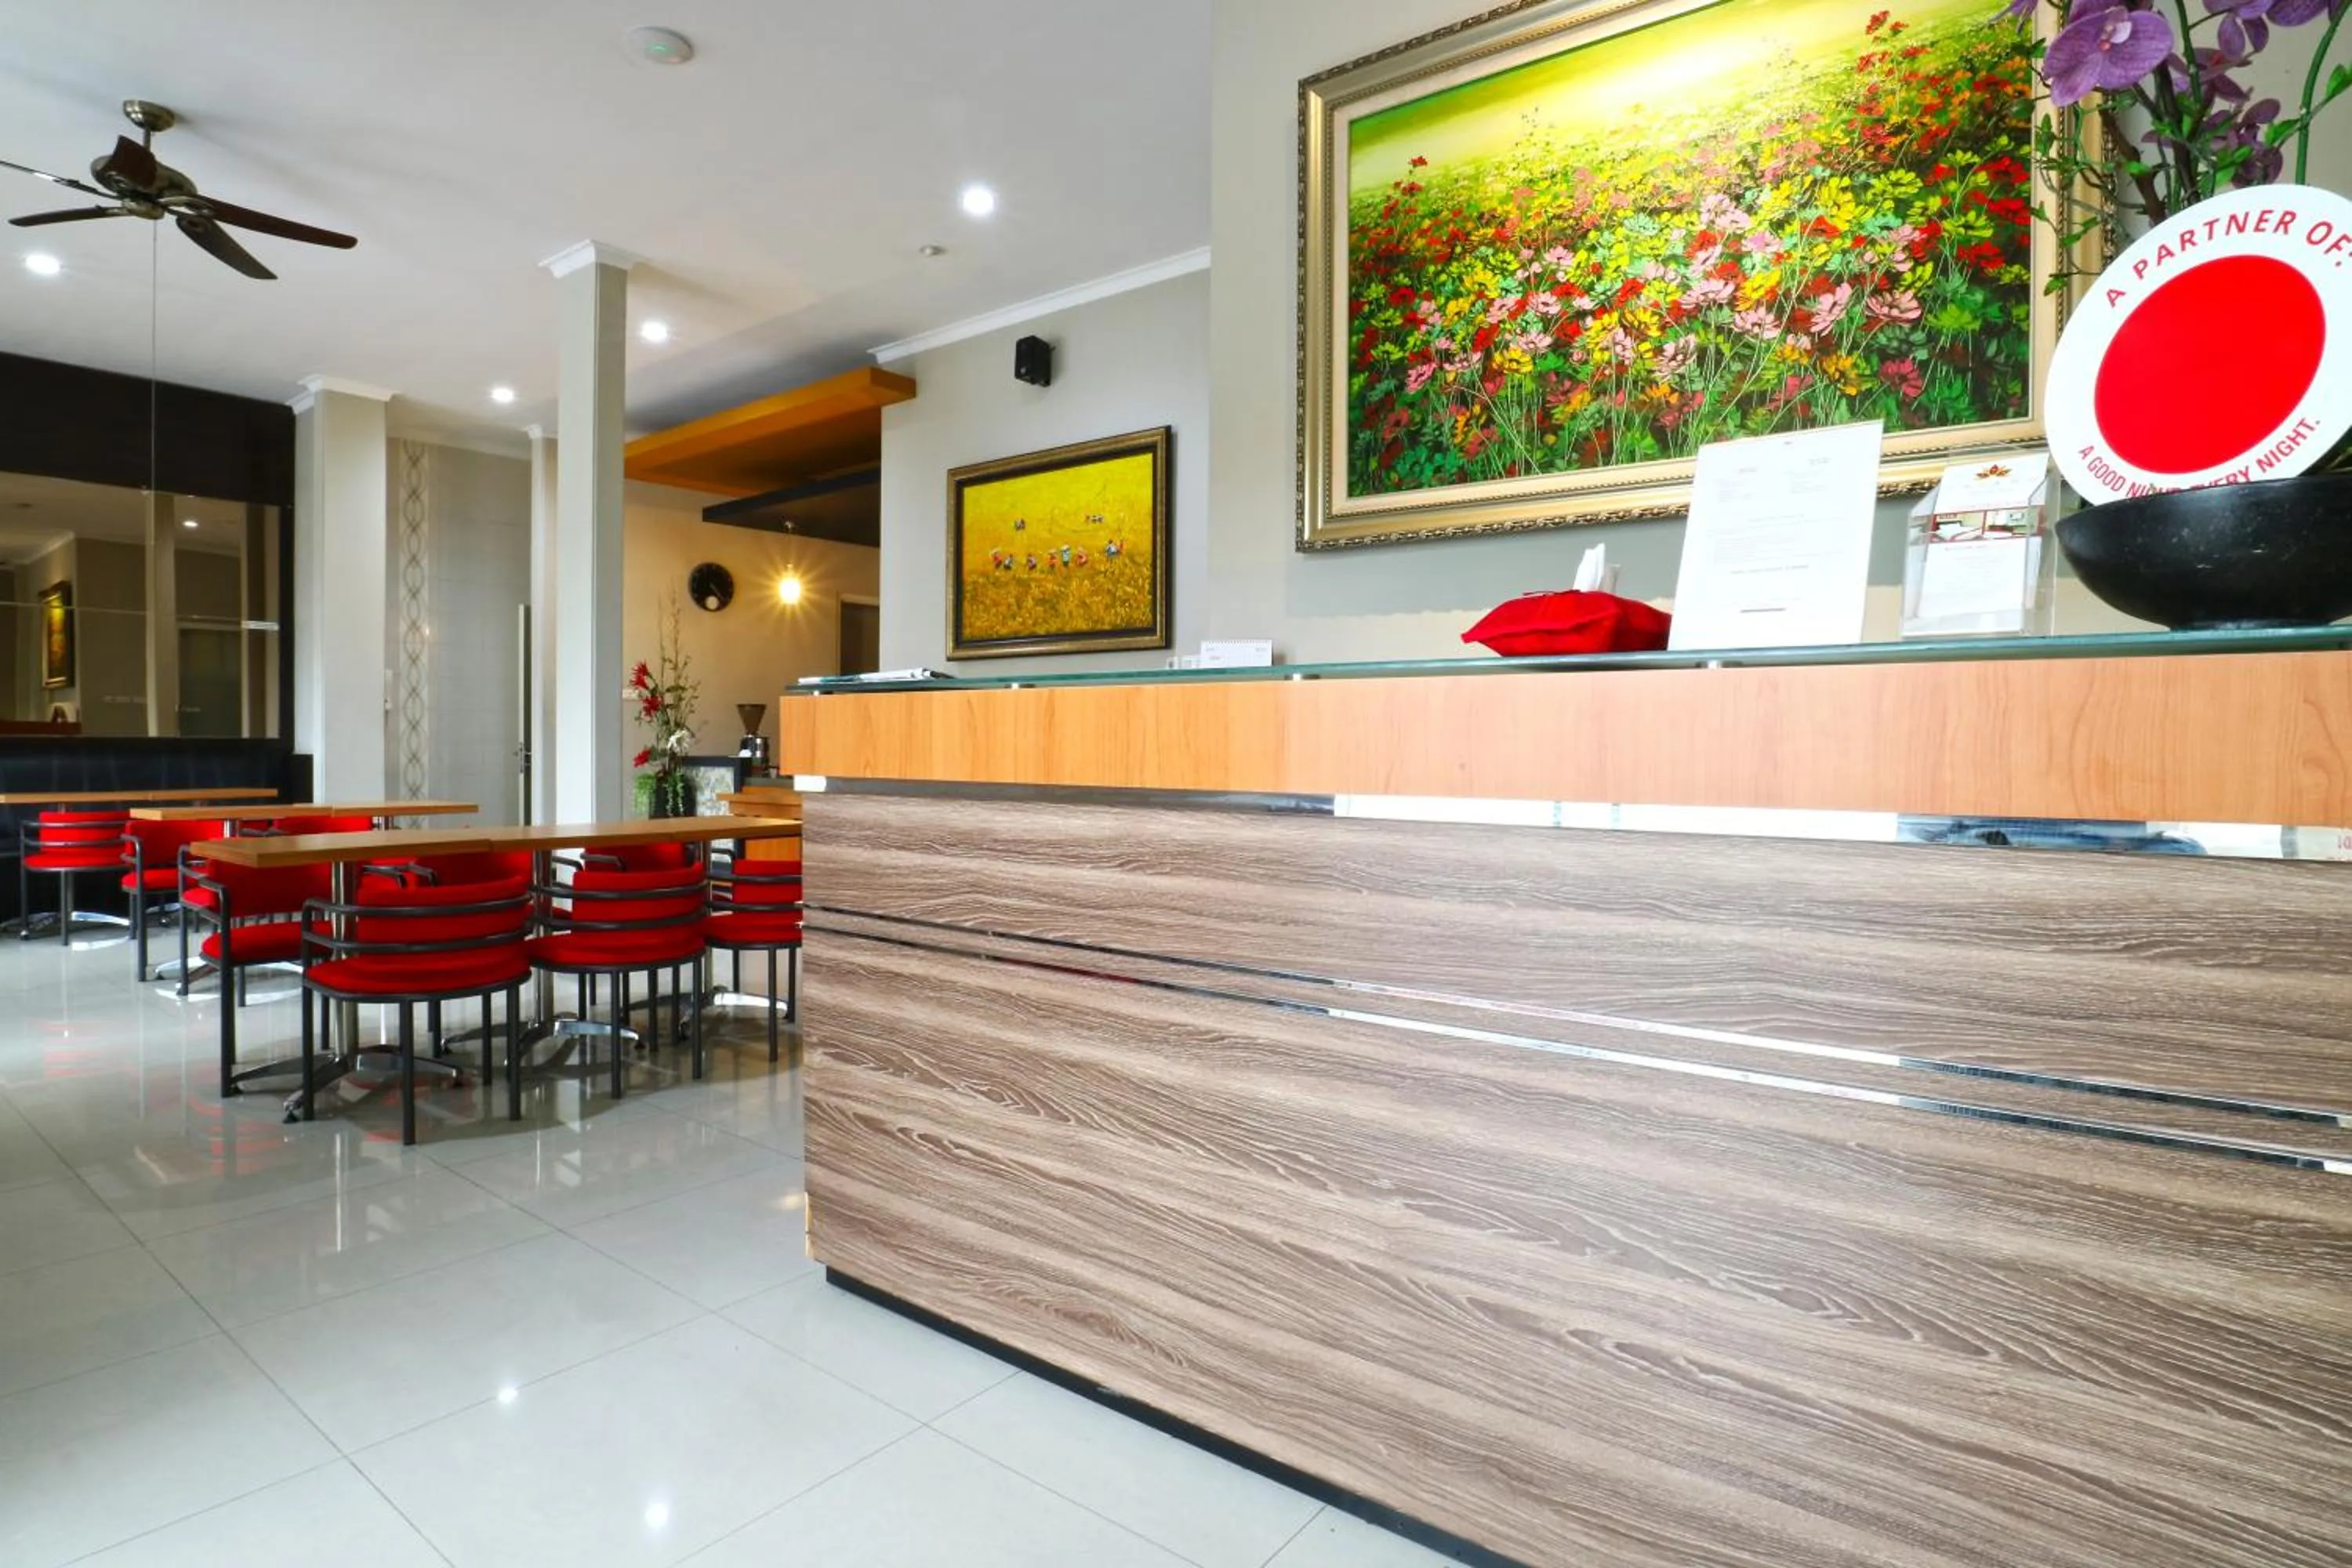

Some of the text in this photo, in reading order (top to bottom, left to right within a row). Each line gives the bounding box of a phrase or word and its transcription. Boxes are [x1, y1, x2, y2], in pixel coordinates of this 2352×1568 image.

[2106, 288, 2126, 307] A
[2132, 209, 2297, 279] PARTNER
[2079, 445, 2095, 459] A
[2087, 457, 2126, 492] GOOD
[2256, 418, 2321, 474] NIGHT.
